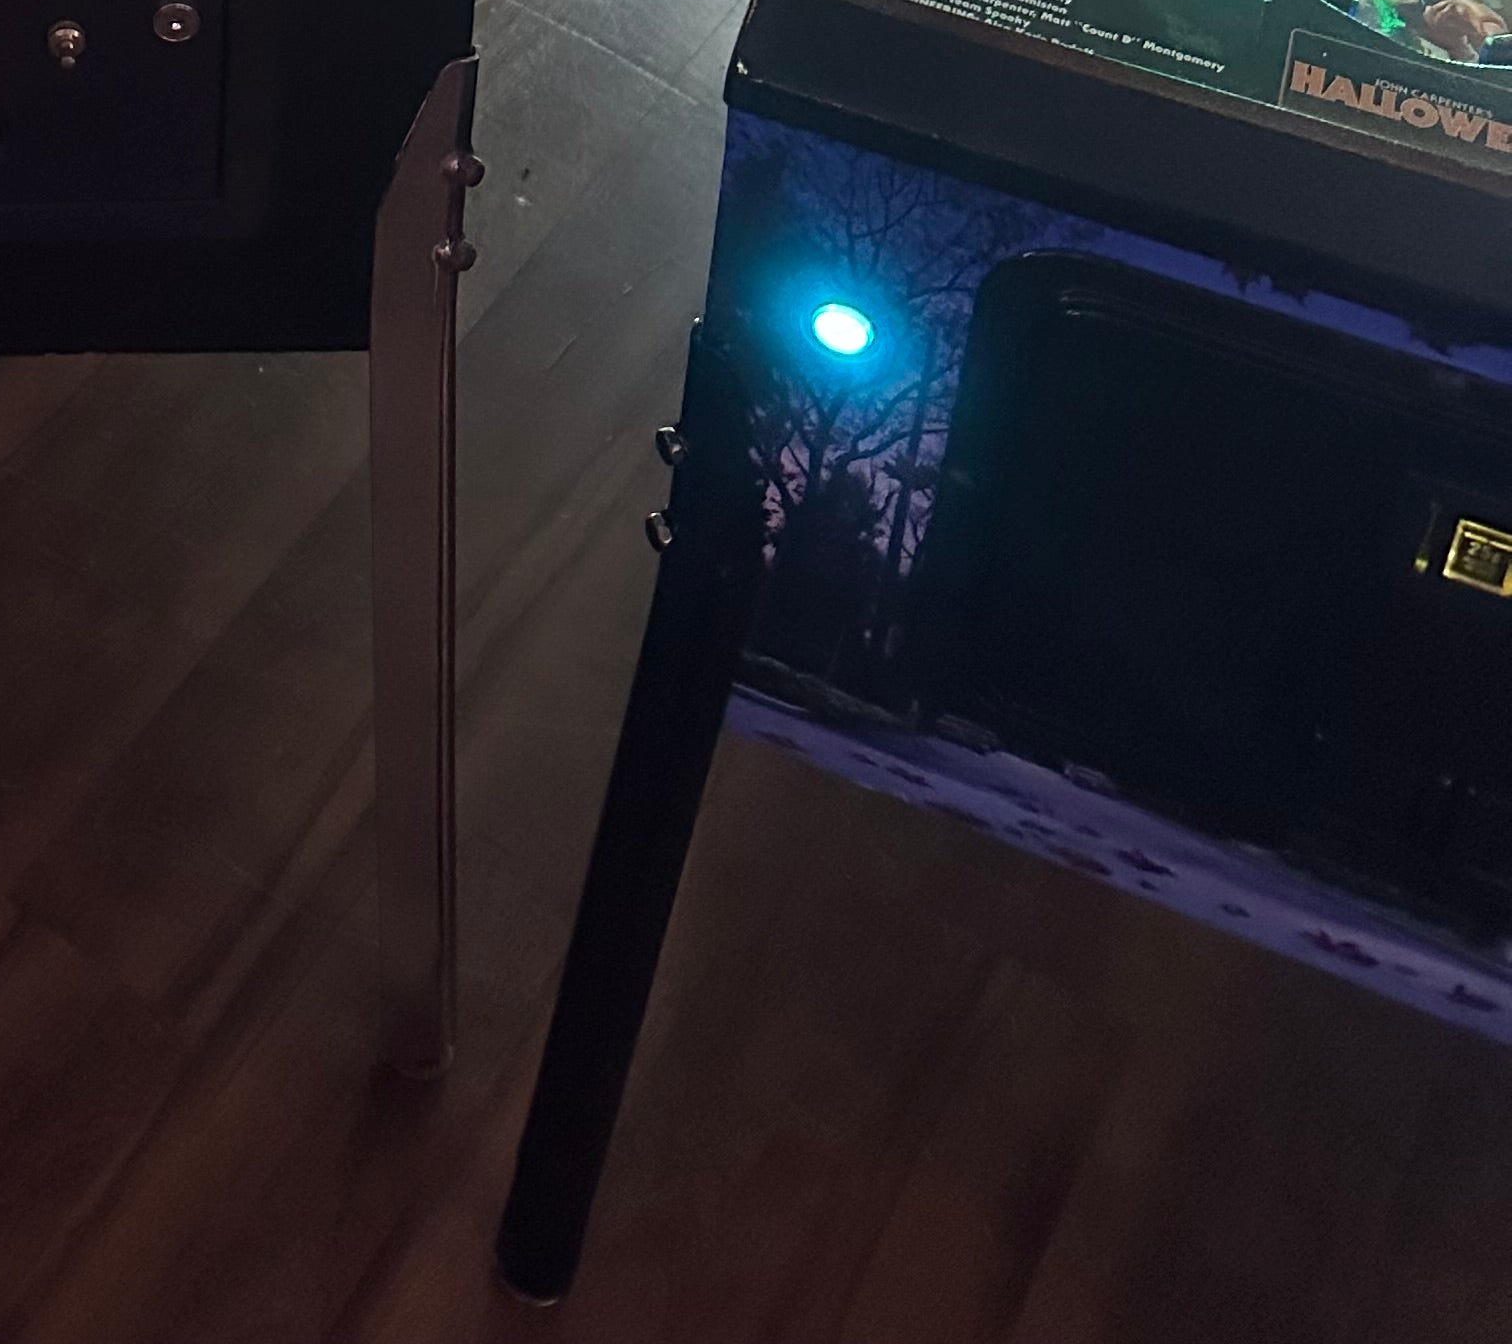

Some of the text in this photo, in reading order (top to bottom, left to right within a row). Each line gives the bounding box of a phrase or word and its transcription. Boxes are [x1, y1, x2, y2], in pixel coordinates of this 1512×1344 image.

[985, 6, 1032, 28] Spooky
[1040, 11, 1071, 28] Matt
[1142, 39, 1226, 74] Montgomery
[1374, 77, 1408, 96] JOHN
